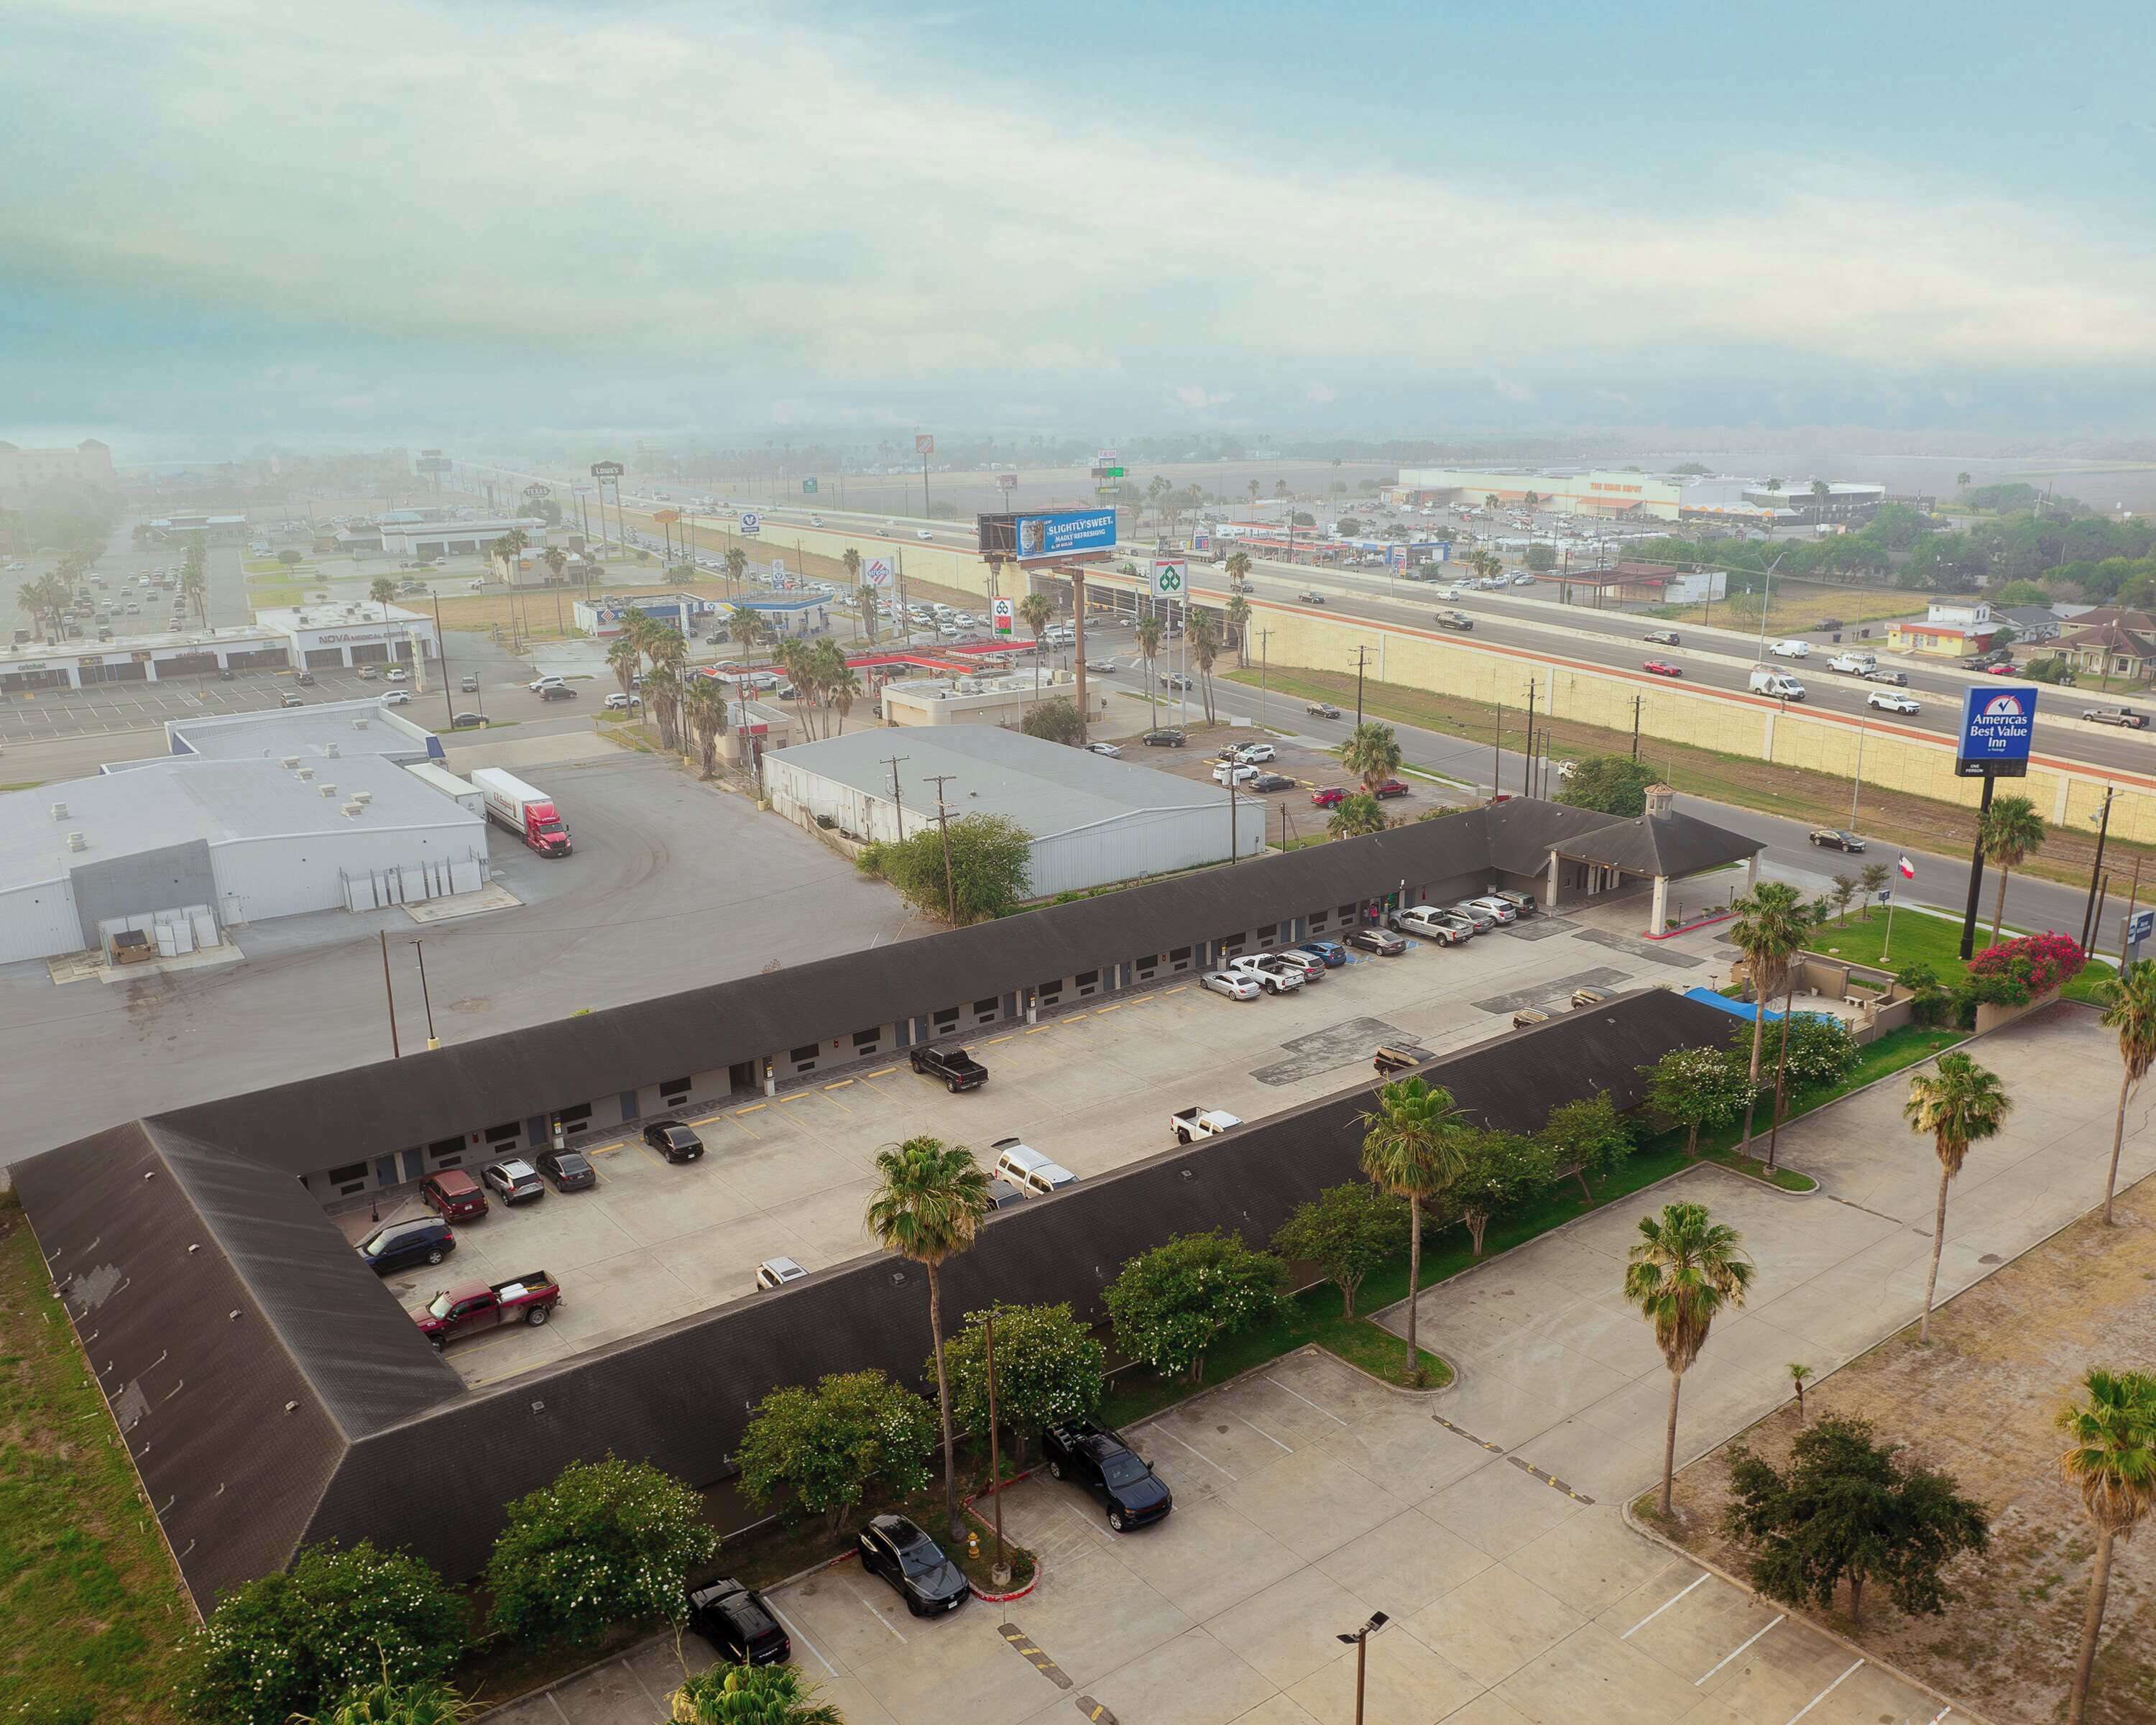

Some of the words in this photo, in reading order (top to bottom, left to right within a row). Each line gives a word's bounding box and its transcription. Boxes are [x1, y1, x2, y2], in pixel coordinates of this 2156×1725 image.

[1603, 483, 1621, 492] HOME
[1623, 484, 1643, 494] DEPOT
[1049, 520, 1086, 535] SLIGHTLY
[1086, 516, 1113, 529] SWEET.
[1074, 528, 1106, 539] REFRESHING
[318, 634, 351, 644] NOVA
[1973, 714, 2027, 724] Americas
[1970, 725, 1994, 737] Best
[1998, 725, 2027, 737] Value
[1988, 737, 2007, 748] Inn
